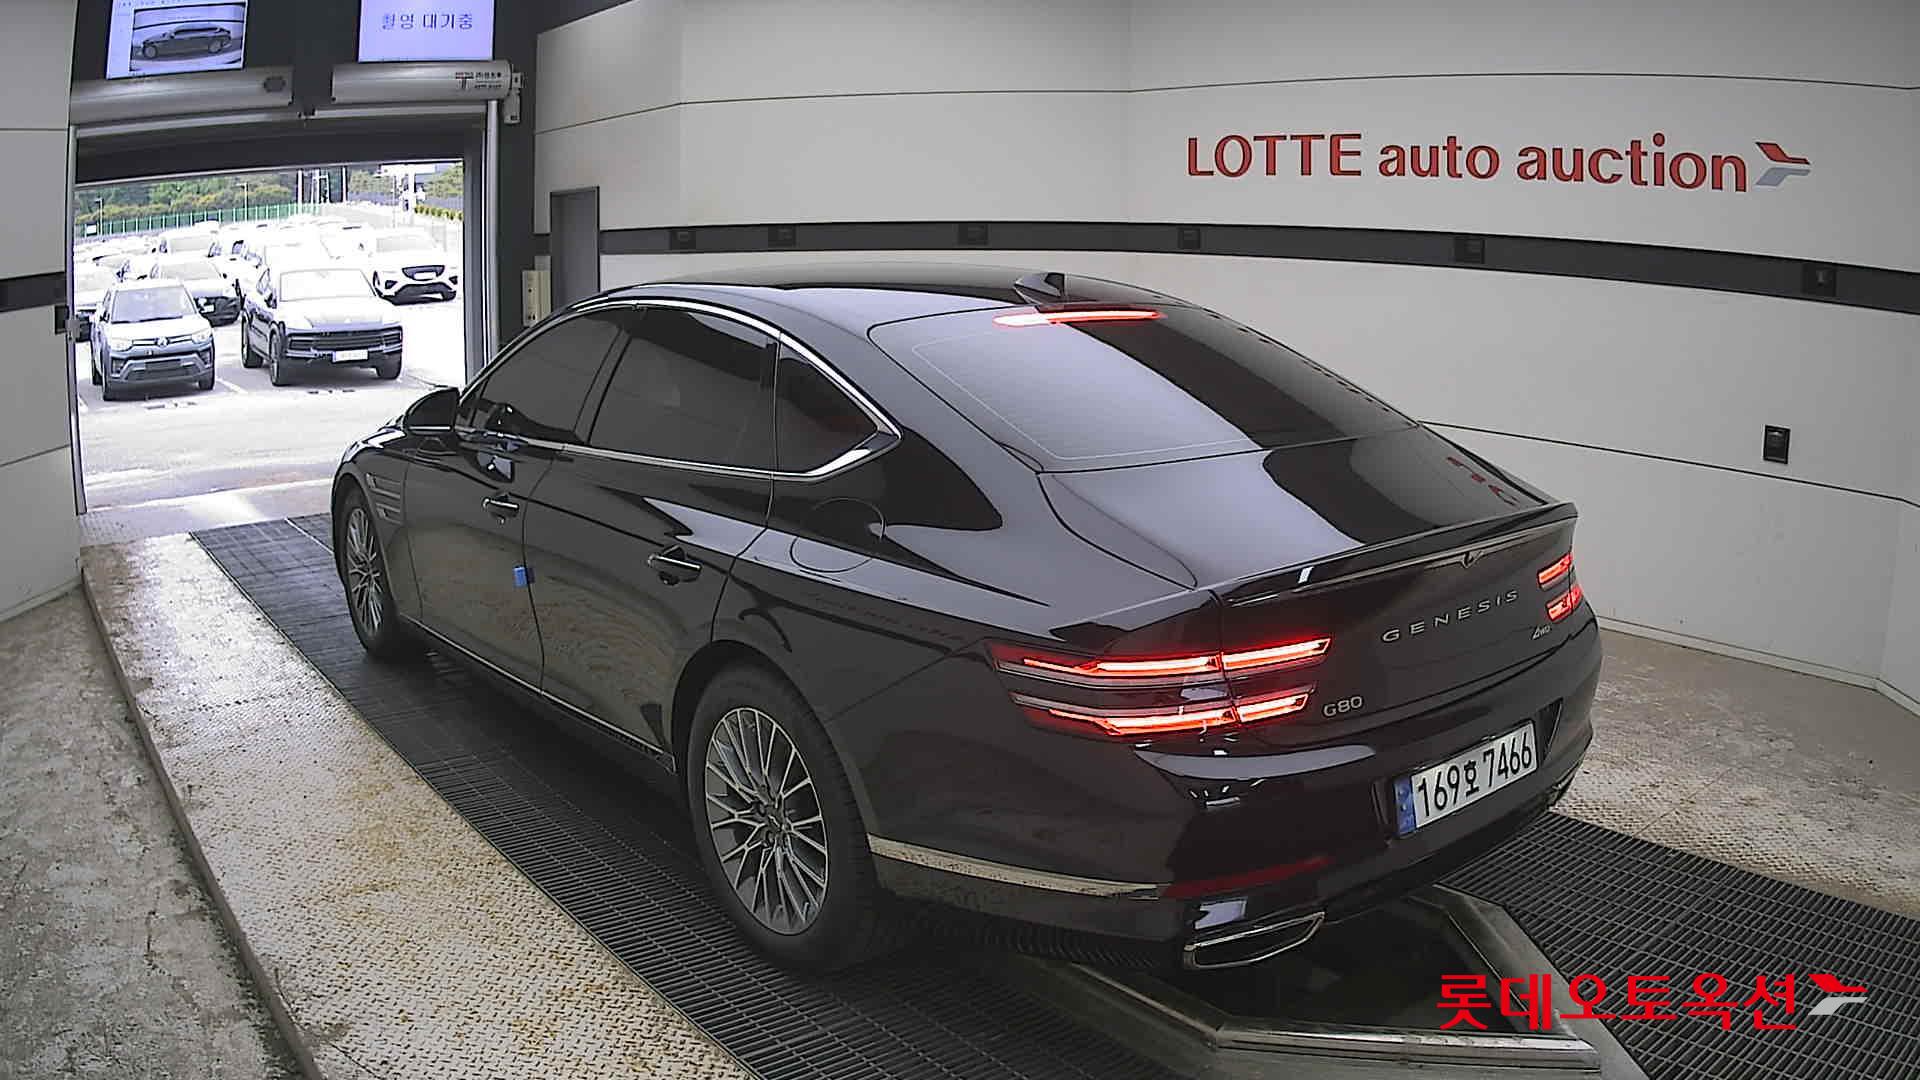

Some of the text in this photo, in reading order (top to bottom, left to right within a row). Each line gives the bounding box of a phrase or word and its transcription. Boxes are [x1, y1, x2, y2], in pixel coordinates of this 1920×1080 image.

[423, 13, 472, 30] 대기중
[1187, 132, 1747, 193] LOTTE auto auction
[1382, 589, 1519, 642] GENESIS
[1323, 695, 1363, 718] G80
[1482, 731, 1533, 788] 7466
